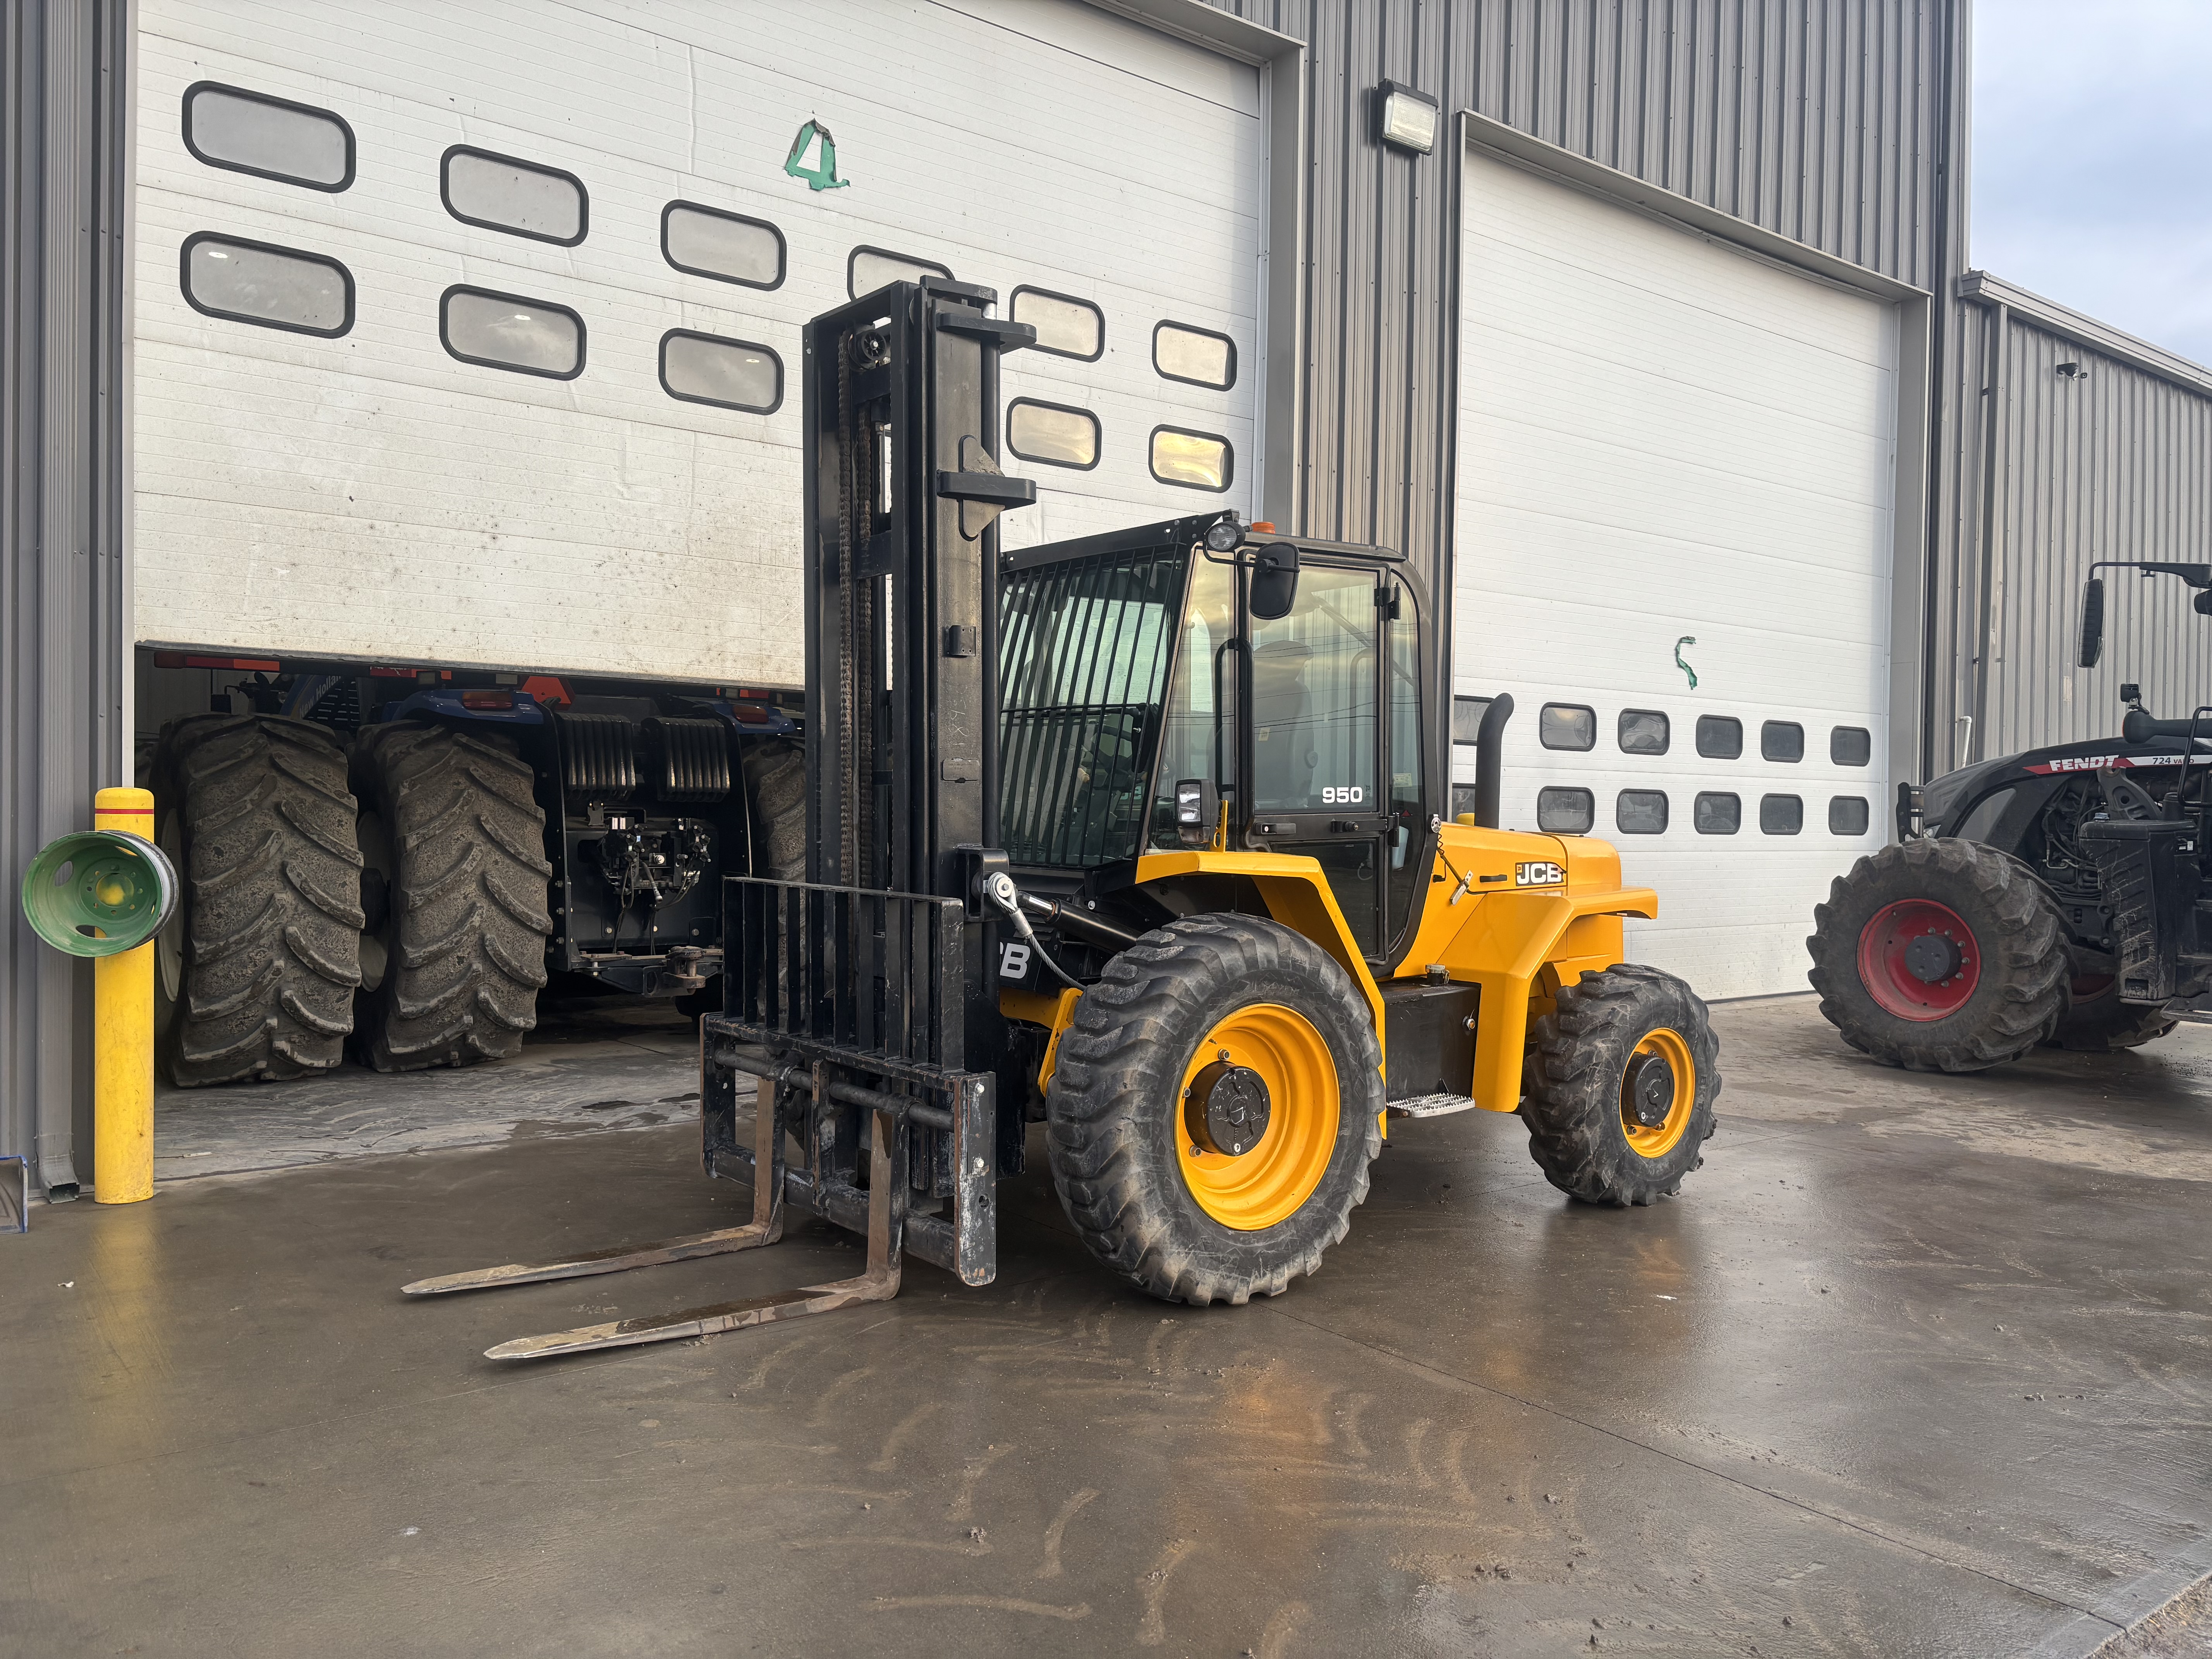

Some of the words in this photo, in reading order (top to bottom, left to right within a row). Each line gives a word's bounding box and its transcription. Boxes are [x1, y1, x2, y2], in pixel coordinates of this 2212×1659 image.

[2049, 755, 2119, 771] FENDT
[1322, 787, 1362, 803] 950
[1516, 863, 1562, 884] JCB
[1000, 942, 1030, 979] B
